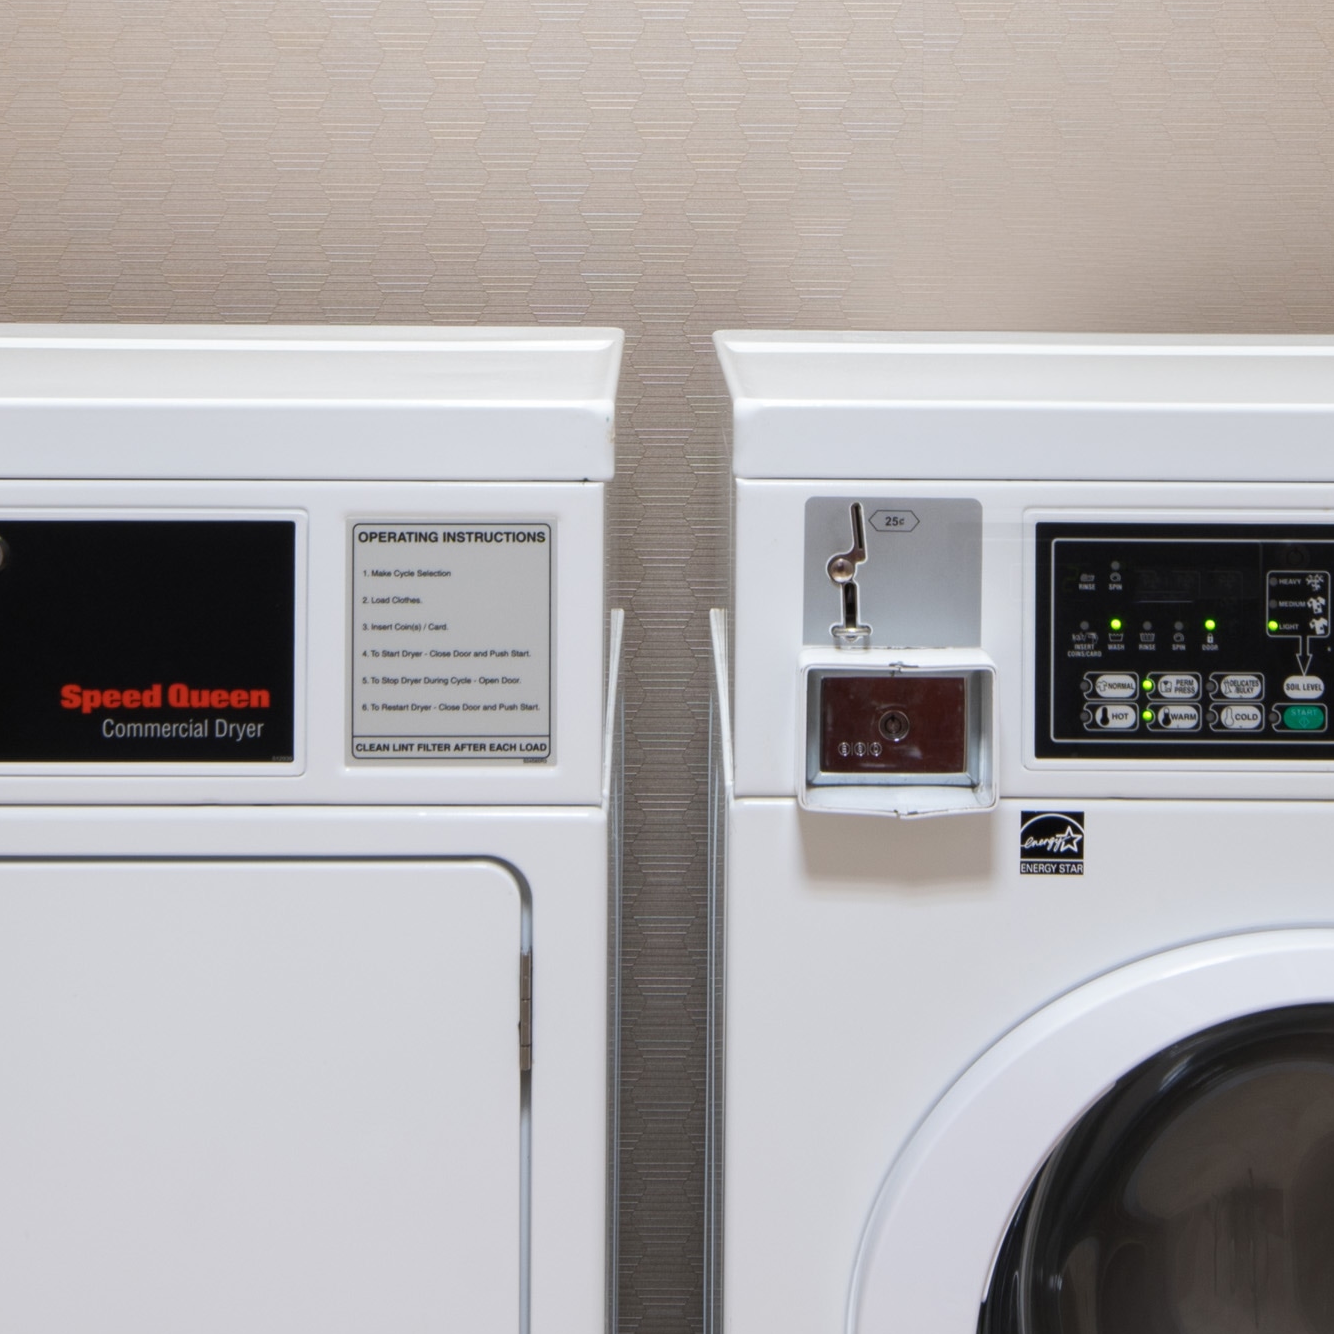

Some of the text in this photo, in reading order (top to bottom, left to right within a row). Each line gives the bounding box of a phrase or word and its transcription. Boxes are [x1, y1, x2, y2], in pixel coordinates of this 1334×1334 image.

[884, 516, 906, 527] 25¢
[358, 531, 546, 543] OPERATING INSTRUCTIONS
[371, 569, 451, 578] Make Cycle Selection
[362, 596, 369, 604] 2.
[392, 596, 422, 604] Clothes.
[371, 623, 449, 632] Insert Coin(s) Card.
[370, 649, 532, 659] To Start Dryer Close Door and Push Start.
[371, 676, 522, 686] To Stop Dryer During Cycle Open Door.
[1286, 683, 1322, 691] SOIL LEVEL
[60, 683, 270, 714] Speed Queen
[371, 703, 380, 711] To
[381, 703, 409, 711] Restart
[410, 703, 432, 713] Dryer
[438, 703, 461, 711] Close
[462, 703, 481, 711] Door
[498, 703, 518, 711] Push
[520, 703, 541, 711] Start.
[102, 719, 264, 741] Commercial Dryer
[355, 743, 547, 752] CLEAN LINT FILTER AFTER EACH LOAD
[1021, 863, 1083, 873] ENERGY STAR
